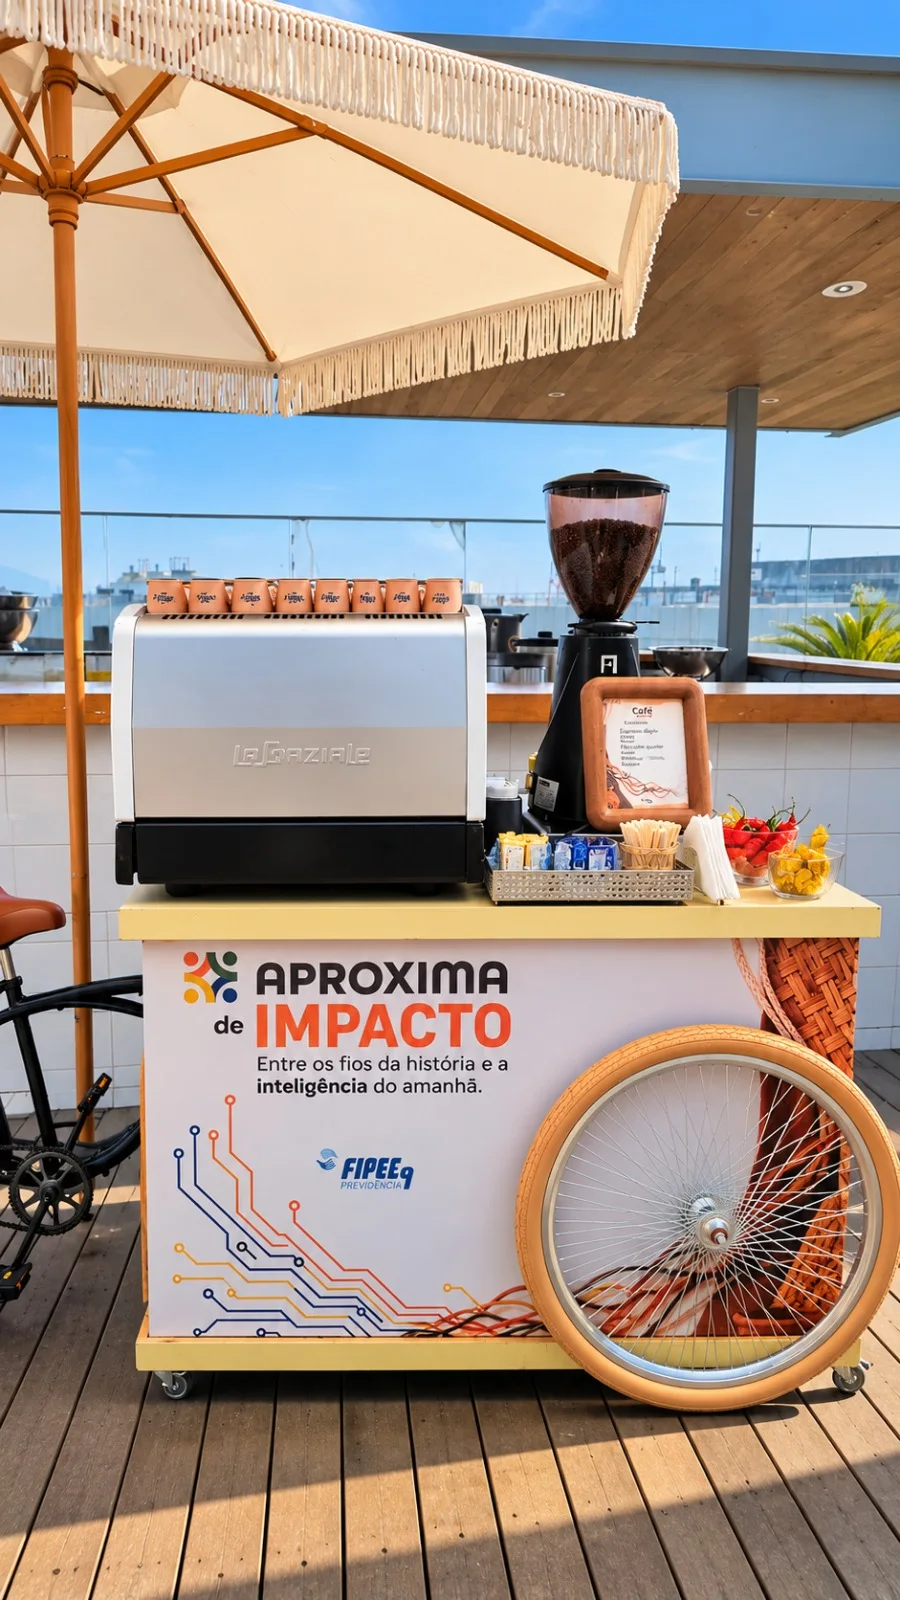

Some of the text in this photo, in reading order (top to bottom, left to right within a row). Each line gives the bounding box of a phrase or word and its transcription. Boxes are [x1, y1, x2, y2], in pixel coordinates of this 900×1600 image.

[632, 706, 653, 715] Café
[256, 960, 508, 996] APROXIMA
[213, 1003, 512, 1048] de IMPACTO
[257, 1055, 509, 1072] Entre os fios da história e a
[256, 1077, 368, 1098] inteligência
[373, 1077, 398, 1094] do
[340, 1180, 402, 1190] PREVIDÊNCIA
